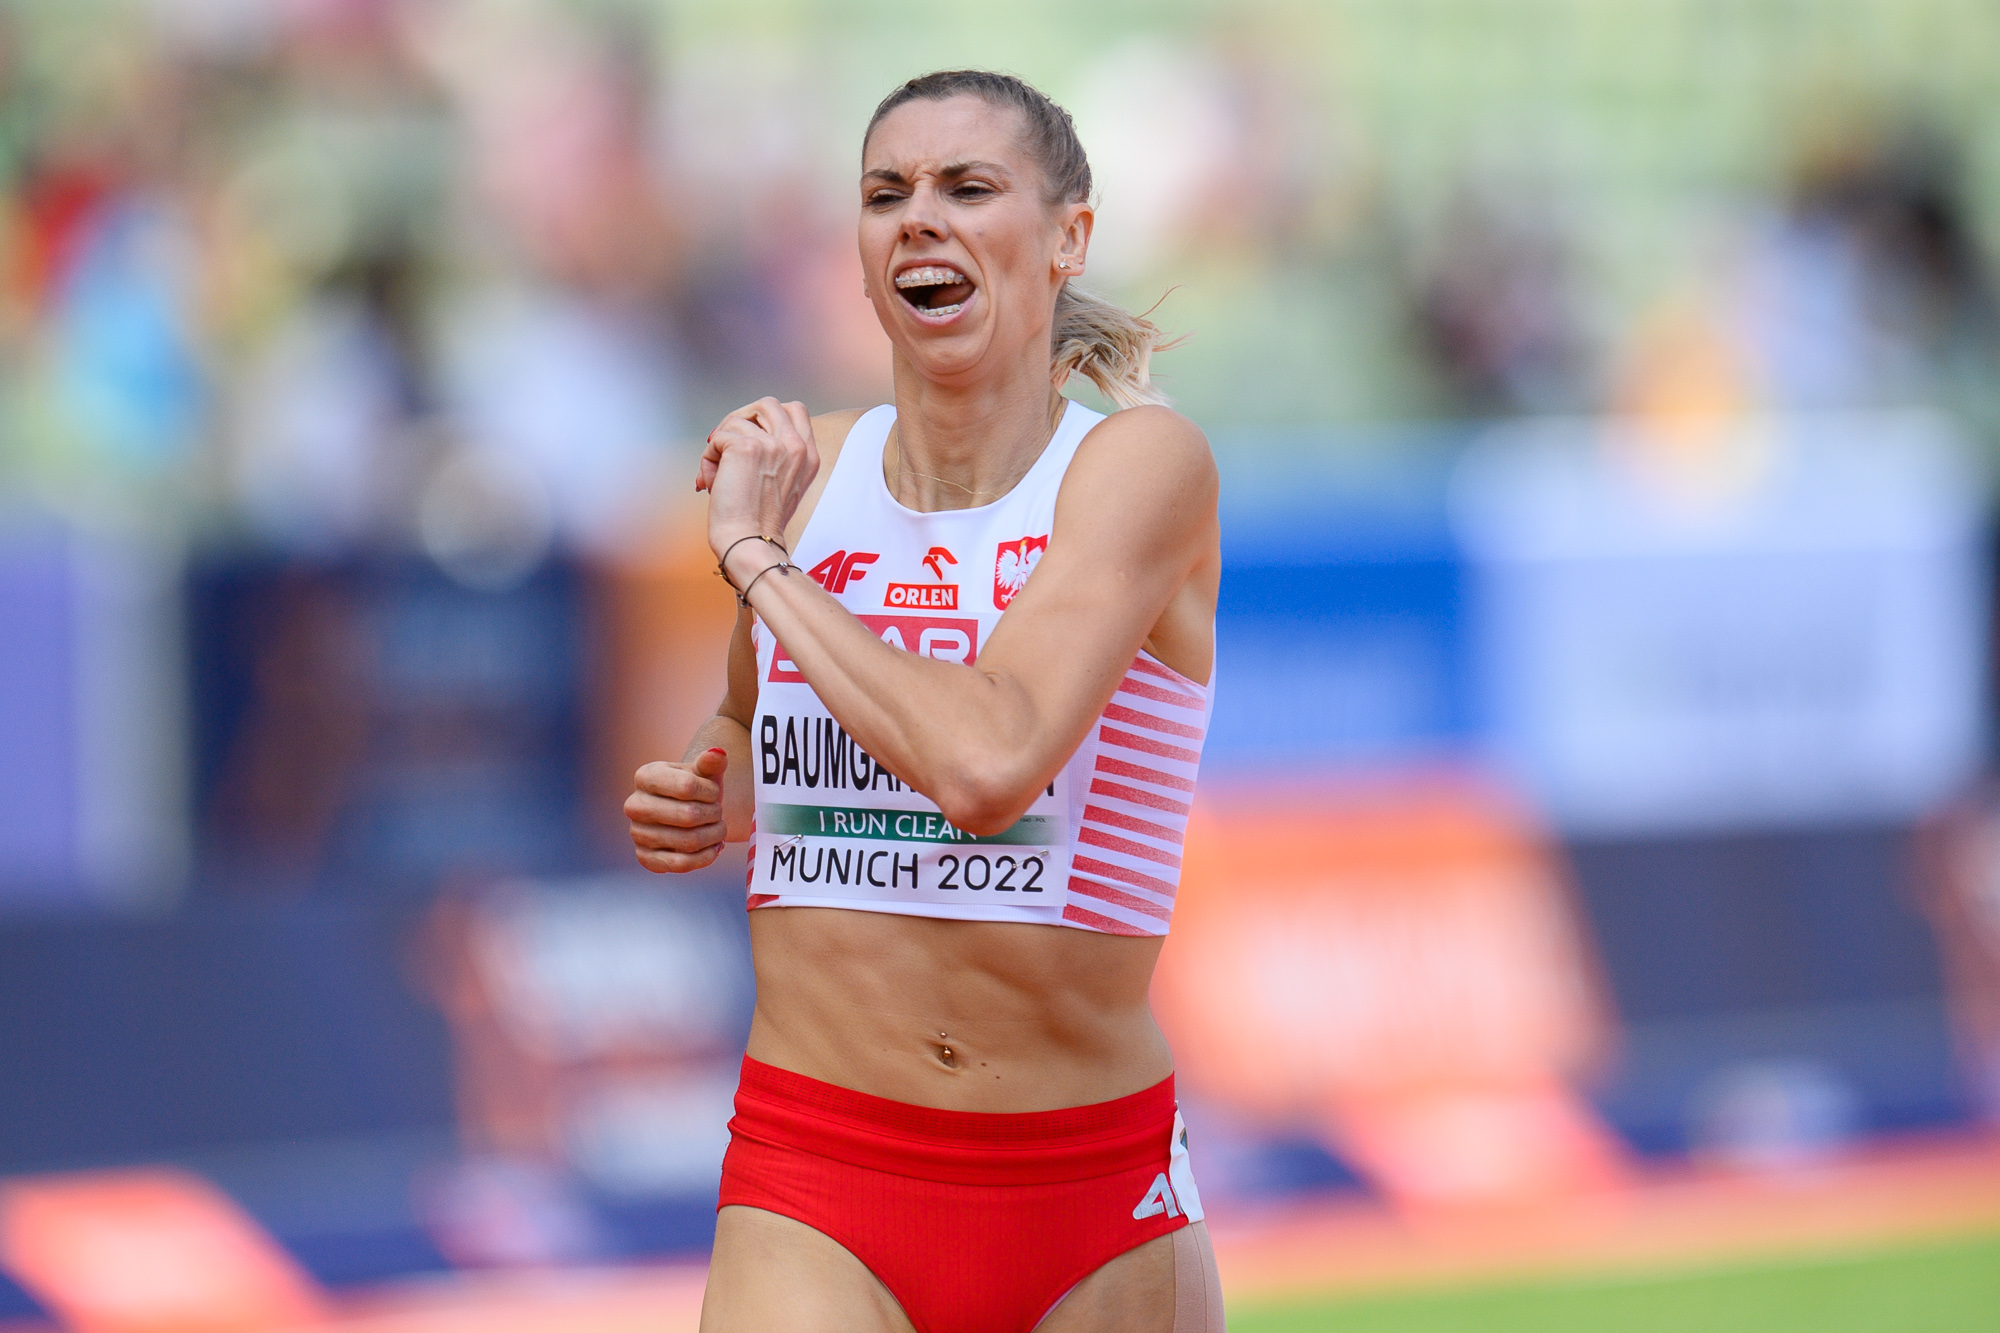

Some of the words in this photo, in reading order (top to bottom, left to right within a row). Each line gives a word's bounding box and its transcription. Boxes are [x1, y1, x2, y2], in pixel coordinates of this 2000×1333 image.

[889, 587, 953, 607] ORLEN
[819, 810, 826, 832] I
[834, 811, 887, 836] RUN
[770, 846, 918, 889] MUNICH
[938, 855, 1044, 892] 2022
